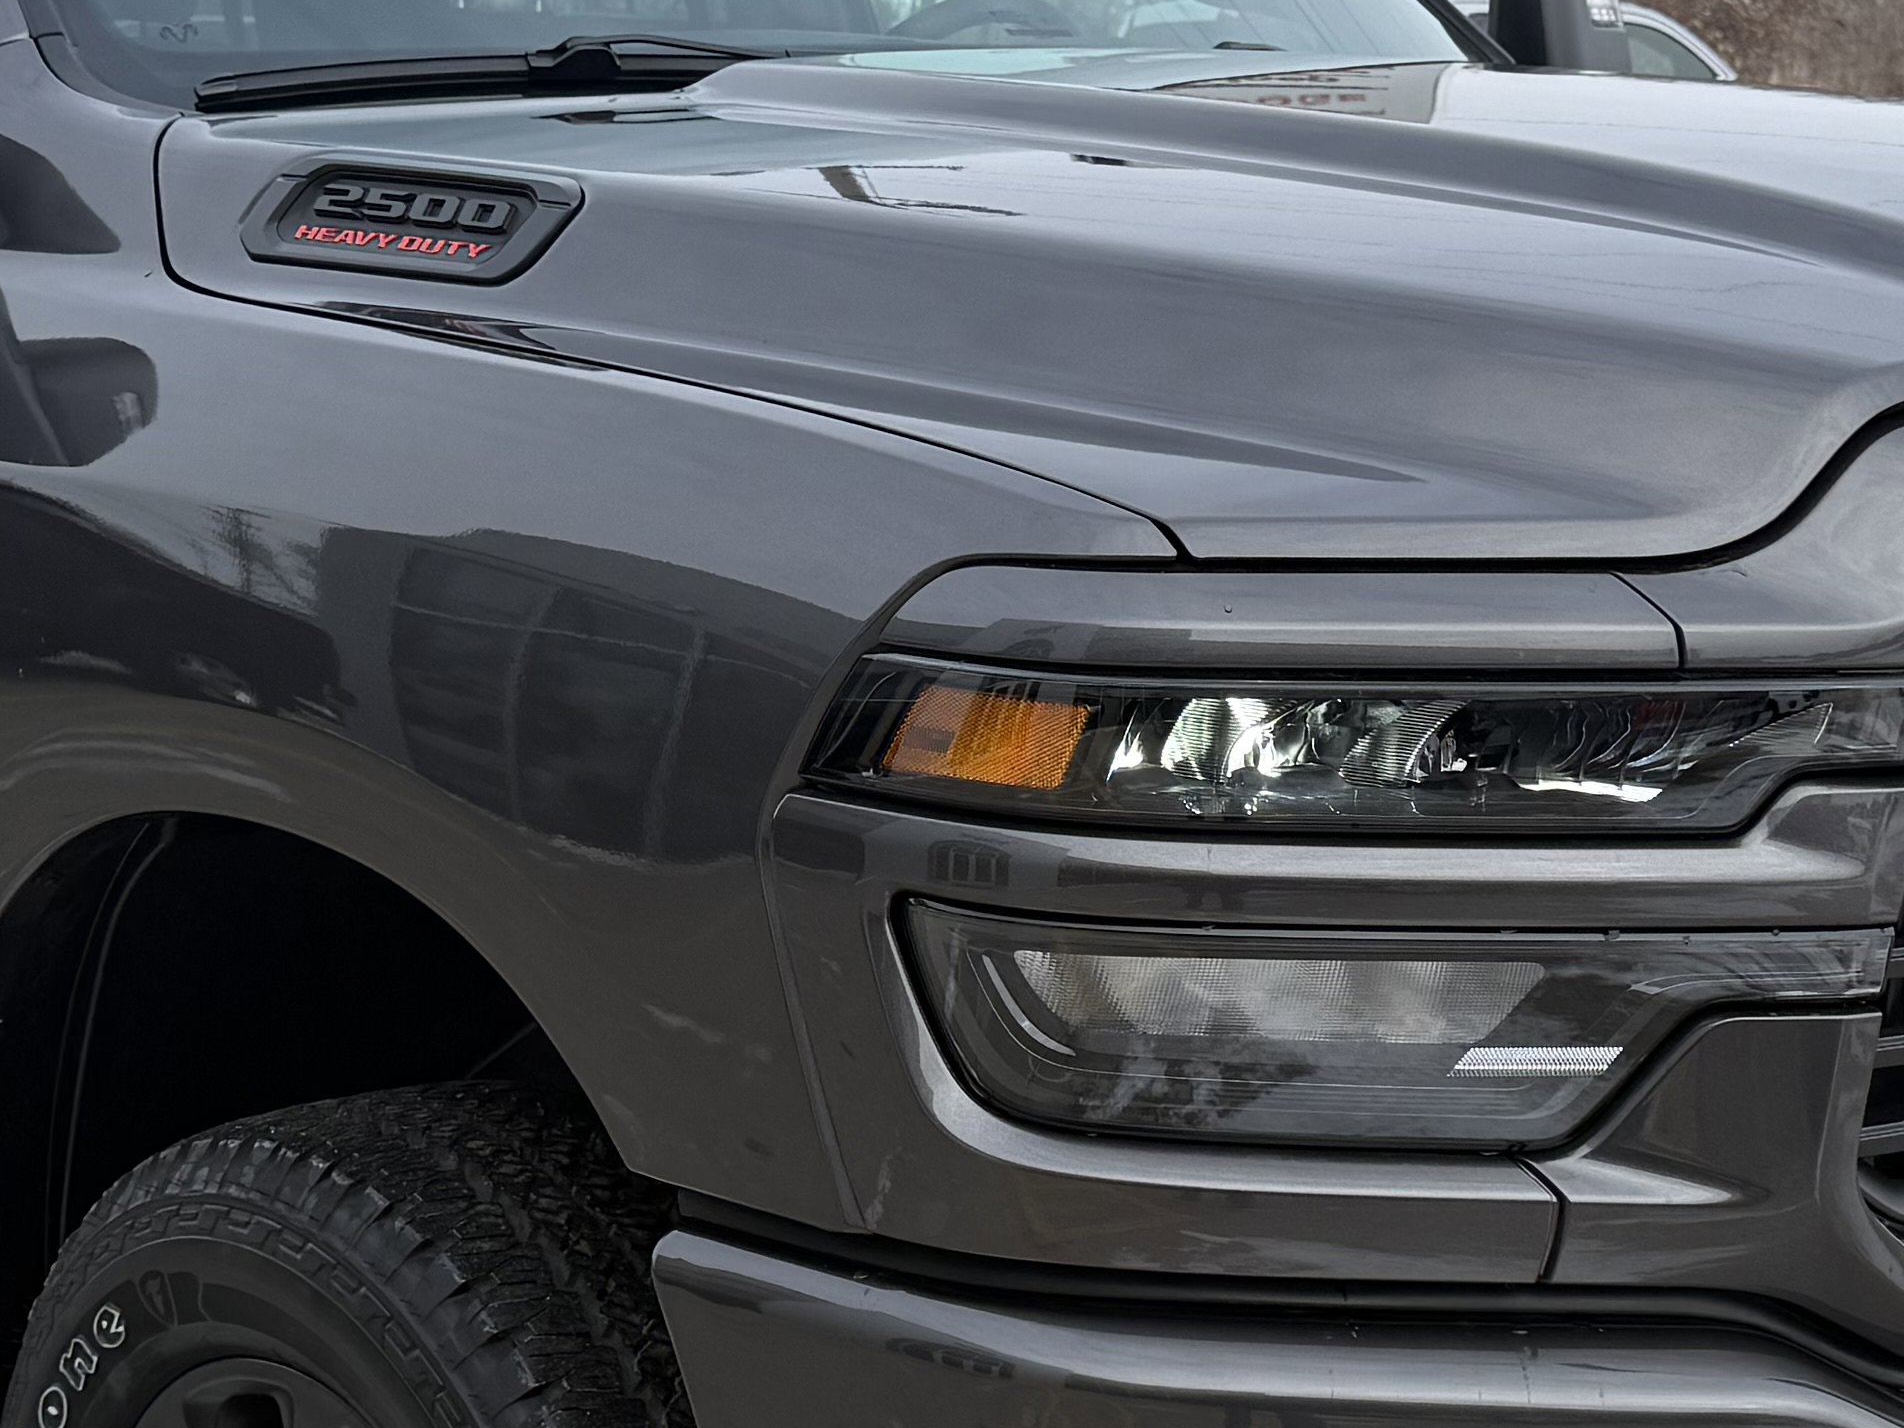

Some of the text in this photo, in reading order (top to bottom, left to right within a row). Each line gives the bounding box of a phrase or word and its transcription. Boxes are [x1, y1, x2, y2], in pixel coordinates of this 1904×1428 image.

[312, 183, 517, 235] 2500
[294, 224, 495, 260] HEAVY DUTY
